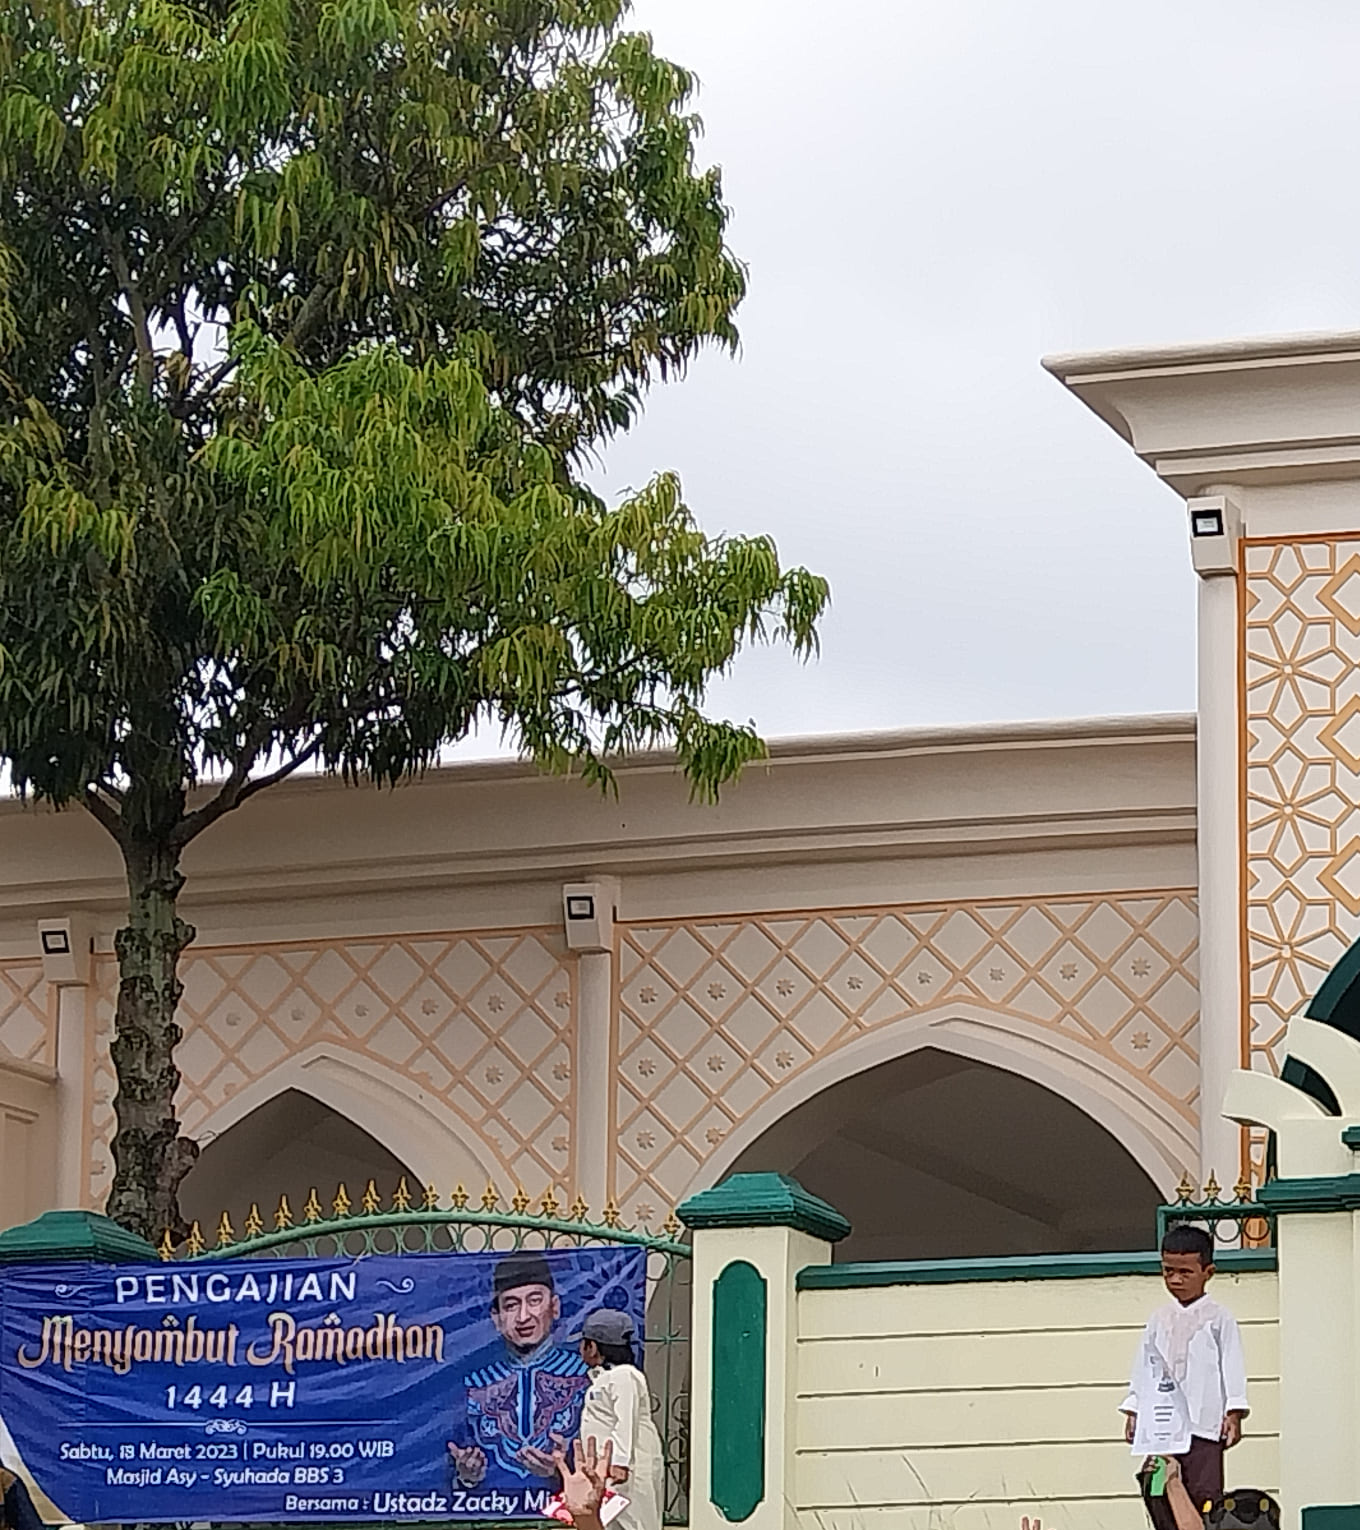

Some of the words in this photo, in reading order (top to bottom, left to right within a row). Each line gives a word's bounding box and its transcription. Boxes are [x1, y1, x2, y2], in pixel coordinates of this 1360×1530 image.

[115, 1272, 357, 1304] PENGAJIAN
[18, 1314, 240, 1376] Menyambut
[246, 1312, 445, 1375] Ramadhan
[165, 1384, 254, 1409] 1444
[270, 1381, 297, 1408] H
[59, 1442, 114, 1462] Sabtu,
[140, 1443, 192, 1460] Maret
[196, 1443, 239, 1460] 2023
[252, 1441, 306, 1460] Pukul
[309, 1442, 355, 1460] 19.00
[358, 1440, 395, 1458] WIB
[106, 1467, 162, 1488] Masjid
[165, 1468, 198, 1488] Asy
[213, 1467, 290, 1489] Syuhada
[294, 1467, 330, 1485] BBS
[333, 1467, 345, 1484] 3
[285, 1495, 359, 1512] Bersama
[374, 1490, 448, 1514] Ustadz
[452, 1491, 520, 1514] Zacky
